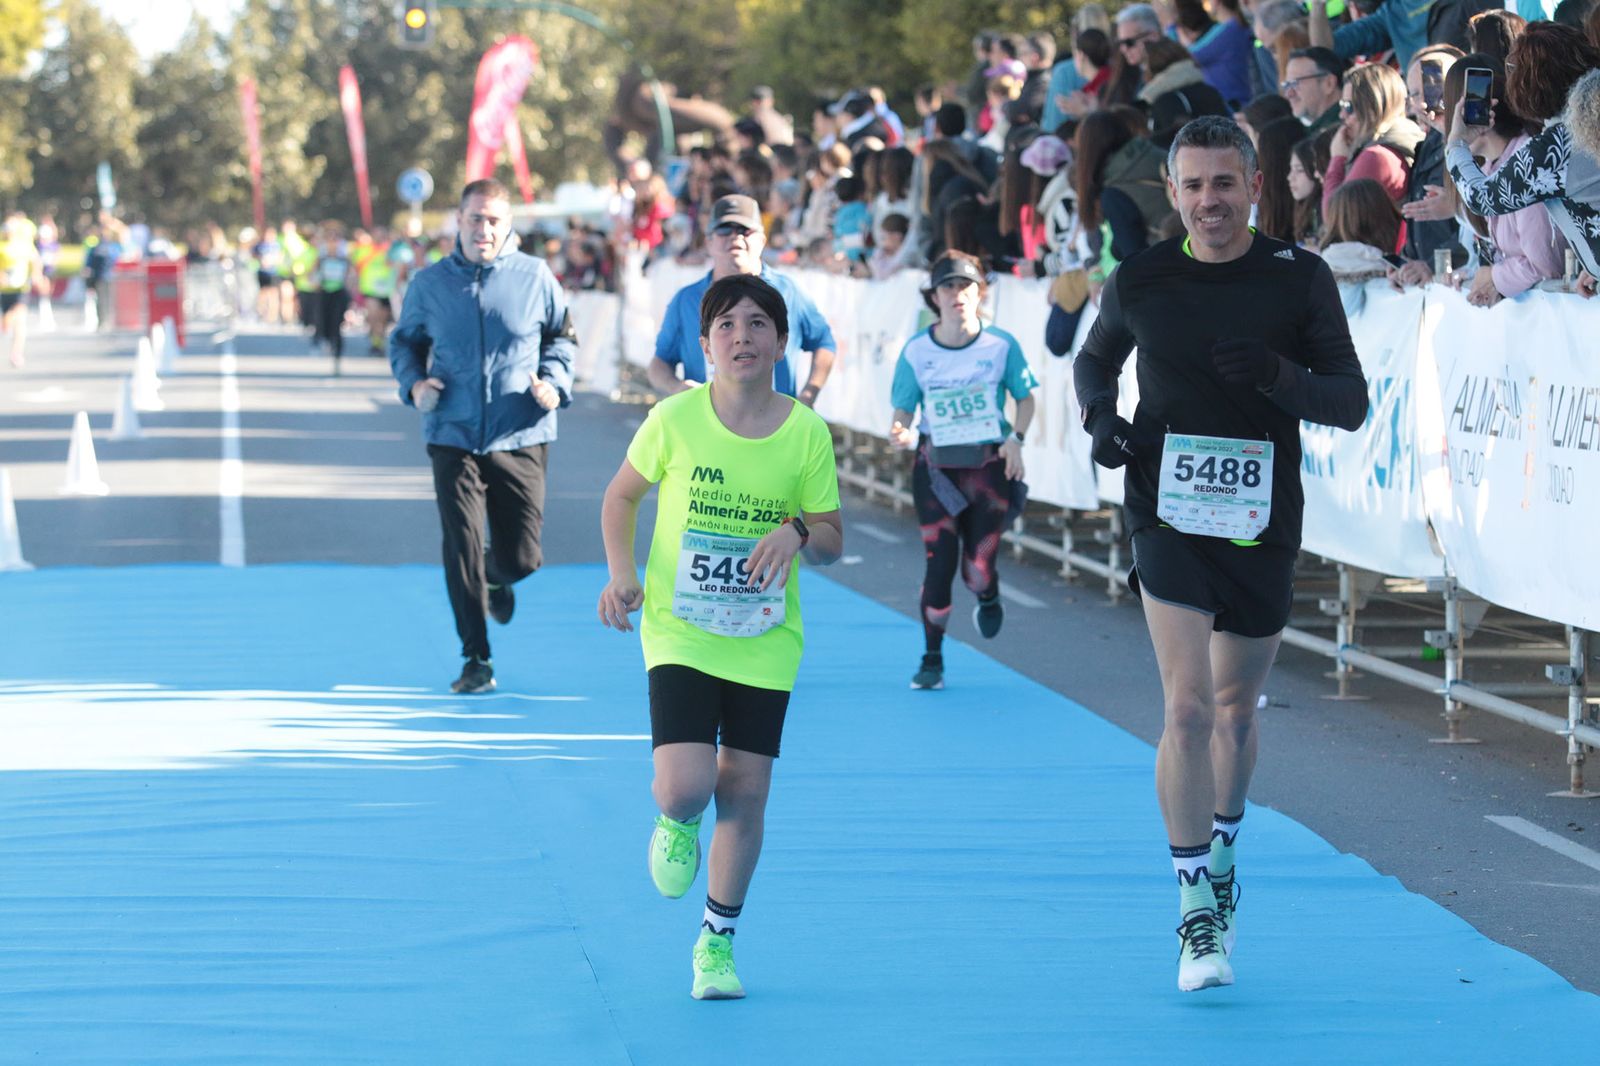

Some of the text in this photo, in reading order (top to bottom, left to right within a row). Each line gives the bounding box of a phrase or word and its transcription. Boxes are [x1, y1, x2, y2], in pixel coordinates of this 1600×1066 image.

[934, 393, 987, 418] 5165
[1174, 454, 1261, 488] 5488
[689, 487, 732, 502] Medio
[1193, 484, 1238, 495] REDONDO
[689, 500, 748, 521] Almería
[687, 519, 721, 530] RAMÓN
[723, 523, 745, 534] RUIZ
[734, 545, 749, 553] 2022
[690, 553, 766, 586] 549
[699, 583, 763, 595] LEO REDONDO
